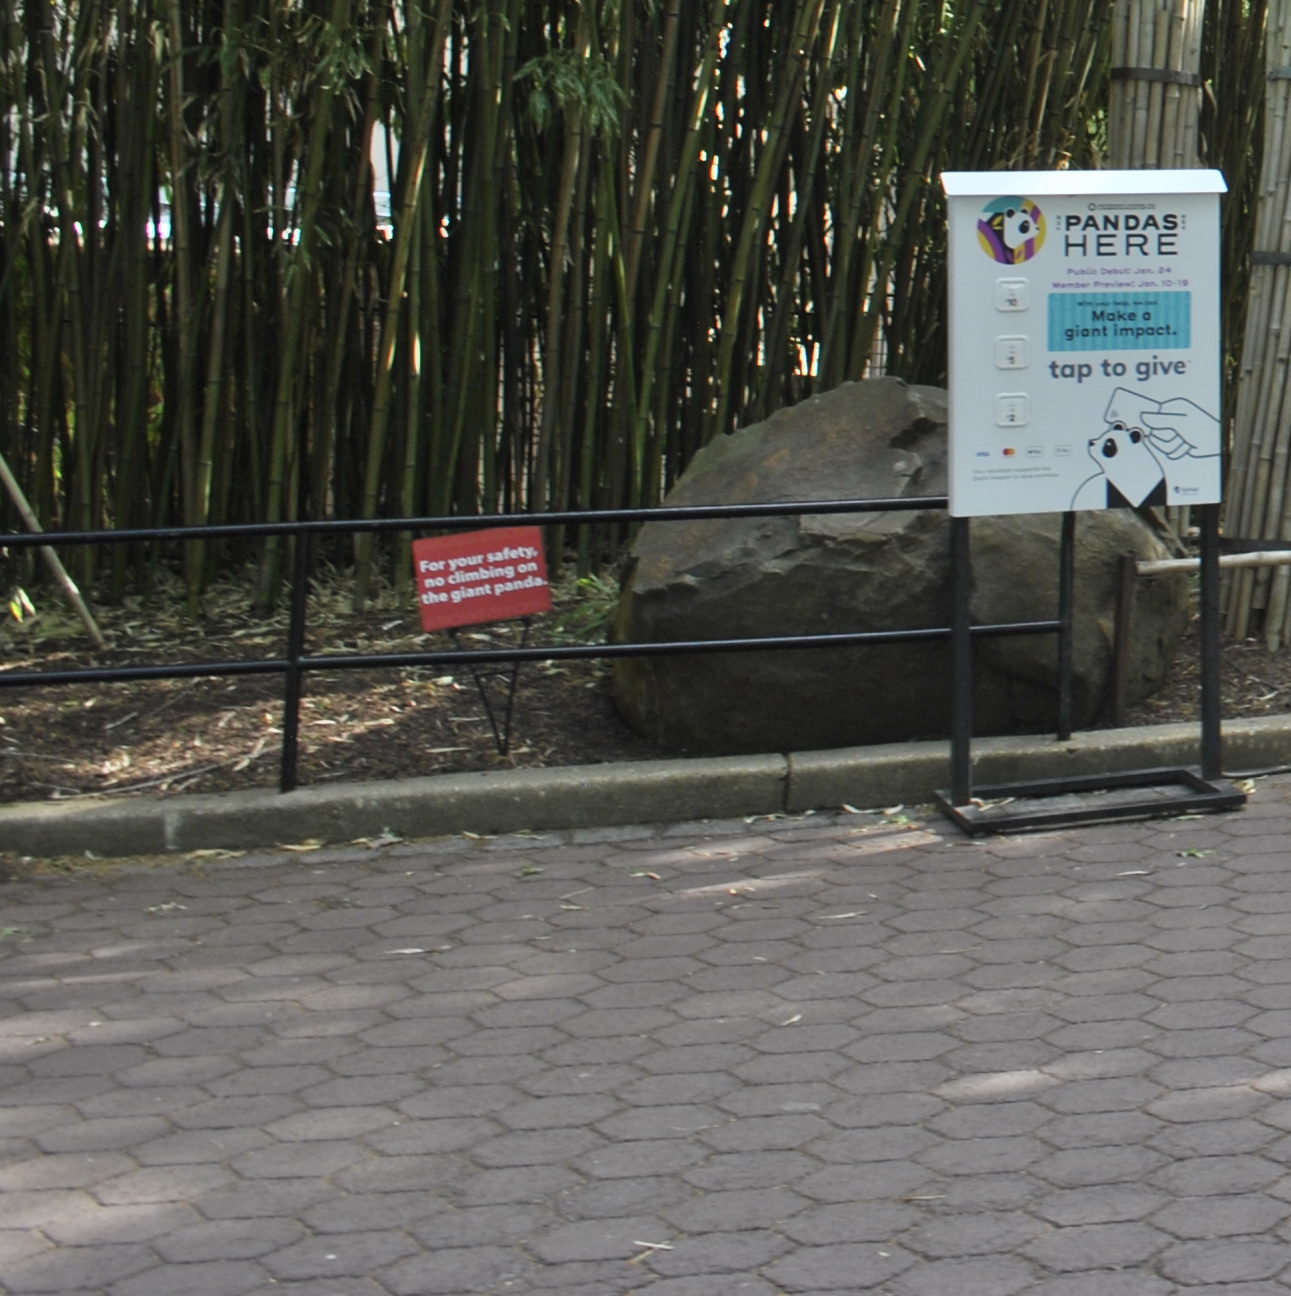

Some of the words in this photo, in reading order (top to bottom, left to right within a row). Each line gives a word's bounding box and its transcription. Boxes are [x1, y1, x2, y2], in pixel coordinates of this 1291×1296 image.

[1065, 214, 1178, 231] PANDAS
[1064, 233, 1178, 256] HERE
[1092, 310, 1136, 322] Make
[1142, 311, 1152, 321] a
[1065, 325, 1108, 341] giant
[1113, 324, 1177, 339] impact.
[1049, 360, 1092, 383] tap
[1101, 359, 1127, 377] to
[1136, 355, 1186, 381] give
[420, 560, 446, 573] For
[448, 554, 484, 571] your
[486, 547, 539, 563] safety,
[424, 577, 445, 588] no
[448, 566, 515, 584] climbing
[517, 562, 538, 573] on
[422, 591, 448, 605] the
[450, 584, 492, 603] giant
[494, 575, 548, 596] panda.
